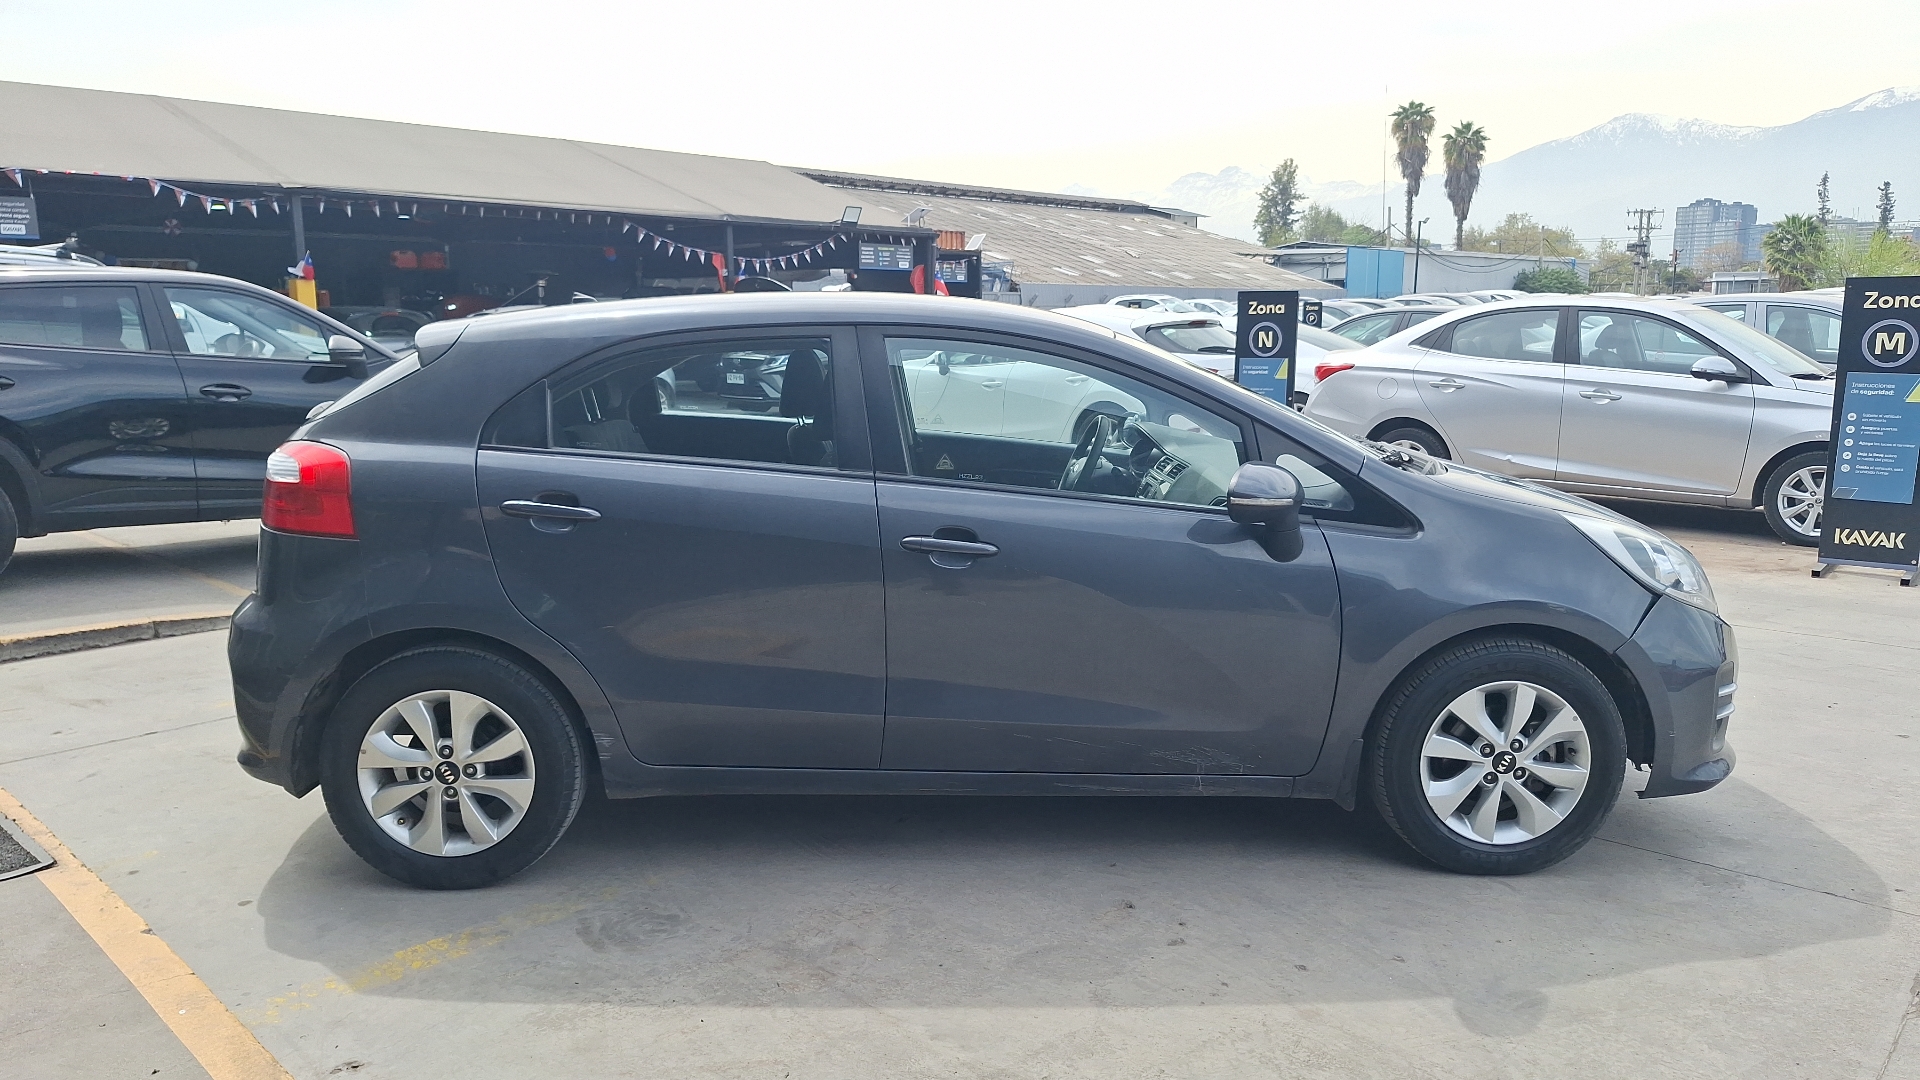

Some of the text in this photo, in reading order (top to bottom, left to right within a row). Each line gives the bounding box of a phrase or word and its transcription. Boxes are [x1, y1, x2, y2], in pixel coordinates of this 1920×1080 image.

[1248, 300, 1285, 315] Zona
[1863, 292, 1920, 308] Zona
[1258, 331, 1273, 348] N
[1874, 332, 1906, 355] M
[1834, 528, 1906, 549] KAVAK
[1496, 754, 1513, 773] KIA
[439, 764, 455, 783] KIA
